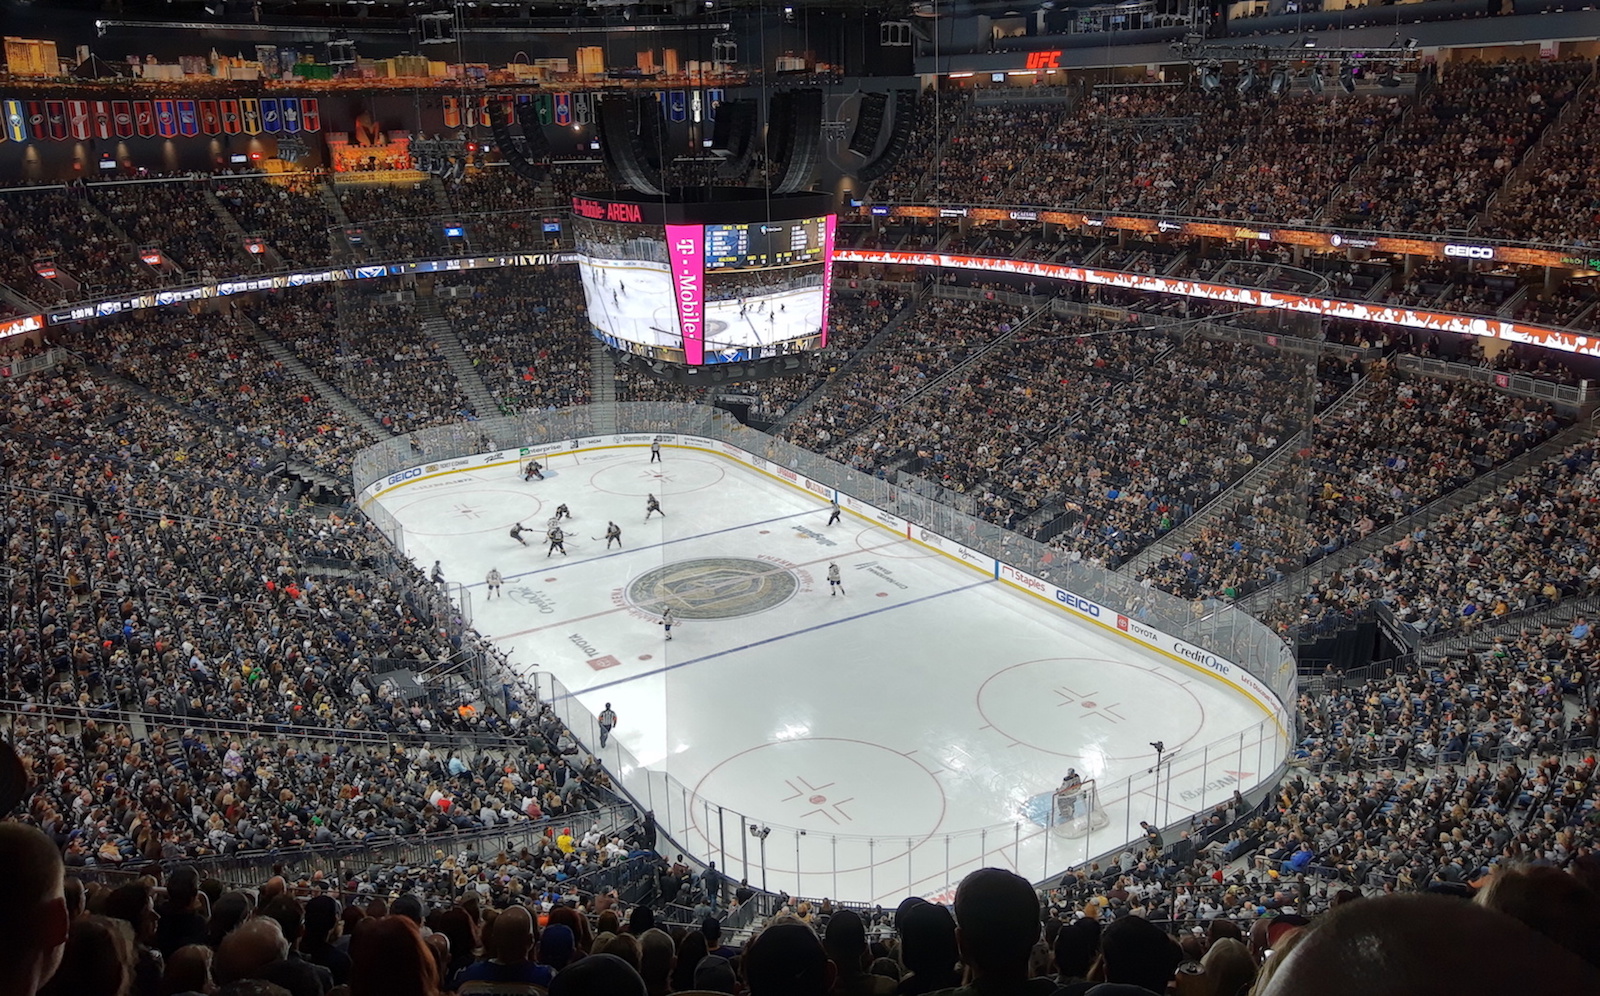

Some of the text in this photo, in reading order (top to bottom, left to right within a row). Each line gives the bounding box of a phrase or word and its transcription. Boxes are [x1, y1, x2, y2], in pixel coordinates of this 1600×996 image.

[1026, 51, 1062, 69] UFC
[607, 203, 642, 222] ARENA
[1444, 244, 1494, 259] GEICO
[71, 308, 85, 319] 9:00
[782, 342, 788, 355] 2
[388, 468, 422, 485] GEICO
[1015, 571, 1046, 592] Staples
[1056, 589, 1100, 617] GEICO
[1130, 623, 1158, 642] TOYOTA
[568, 633, 599, 658] TOYOTA
[1173, 642, 1230, 675] CreditOne
